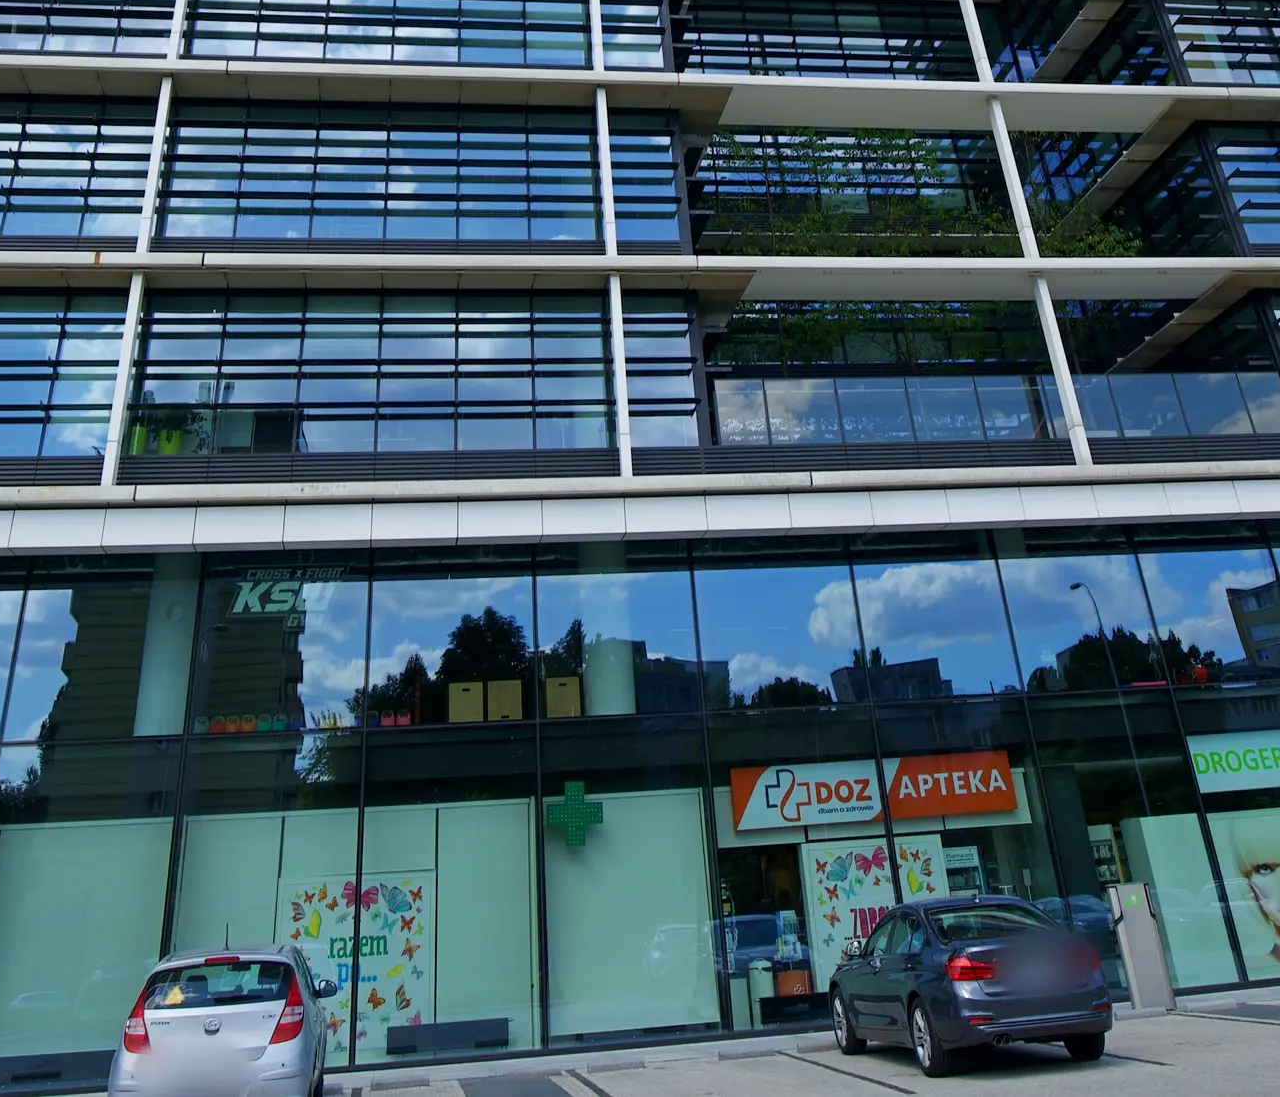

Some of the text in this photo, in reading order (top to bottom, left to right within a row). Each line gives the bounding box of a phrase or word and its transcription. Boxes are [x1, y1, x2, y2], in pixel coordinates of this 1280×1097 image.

[246, 569, 292, 580] CROSS
[305, 567, 345, 579] FIGHT
[815, 769, 1007, 805] DOZ APTEKA
[818, 806, 839, 814] dbam
[845, 804, 874, 812] zdrowie
